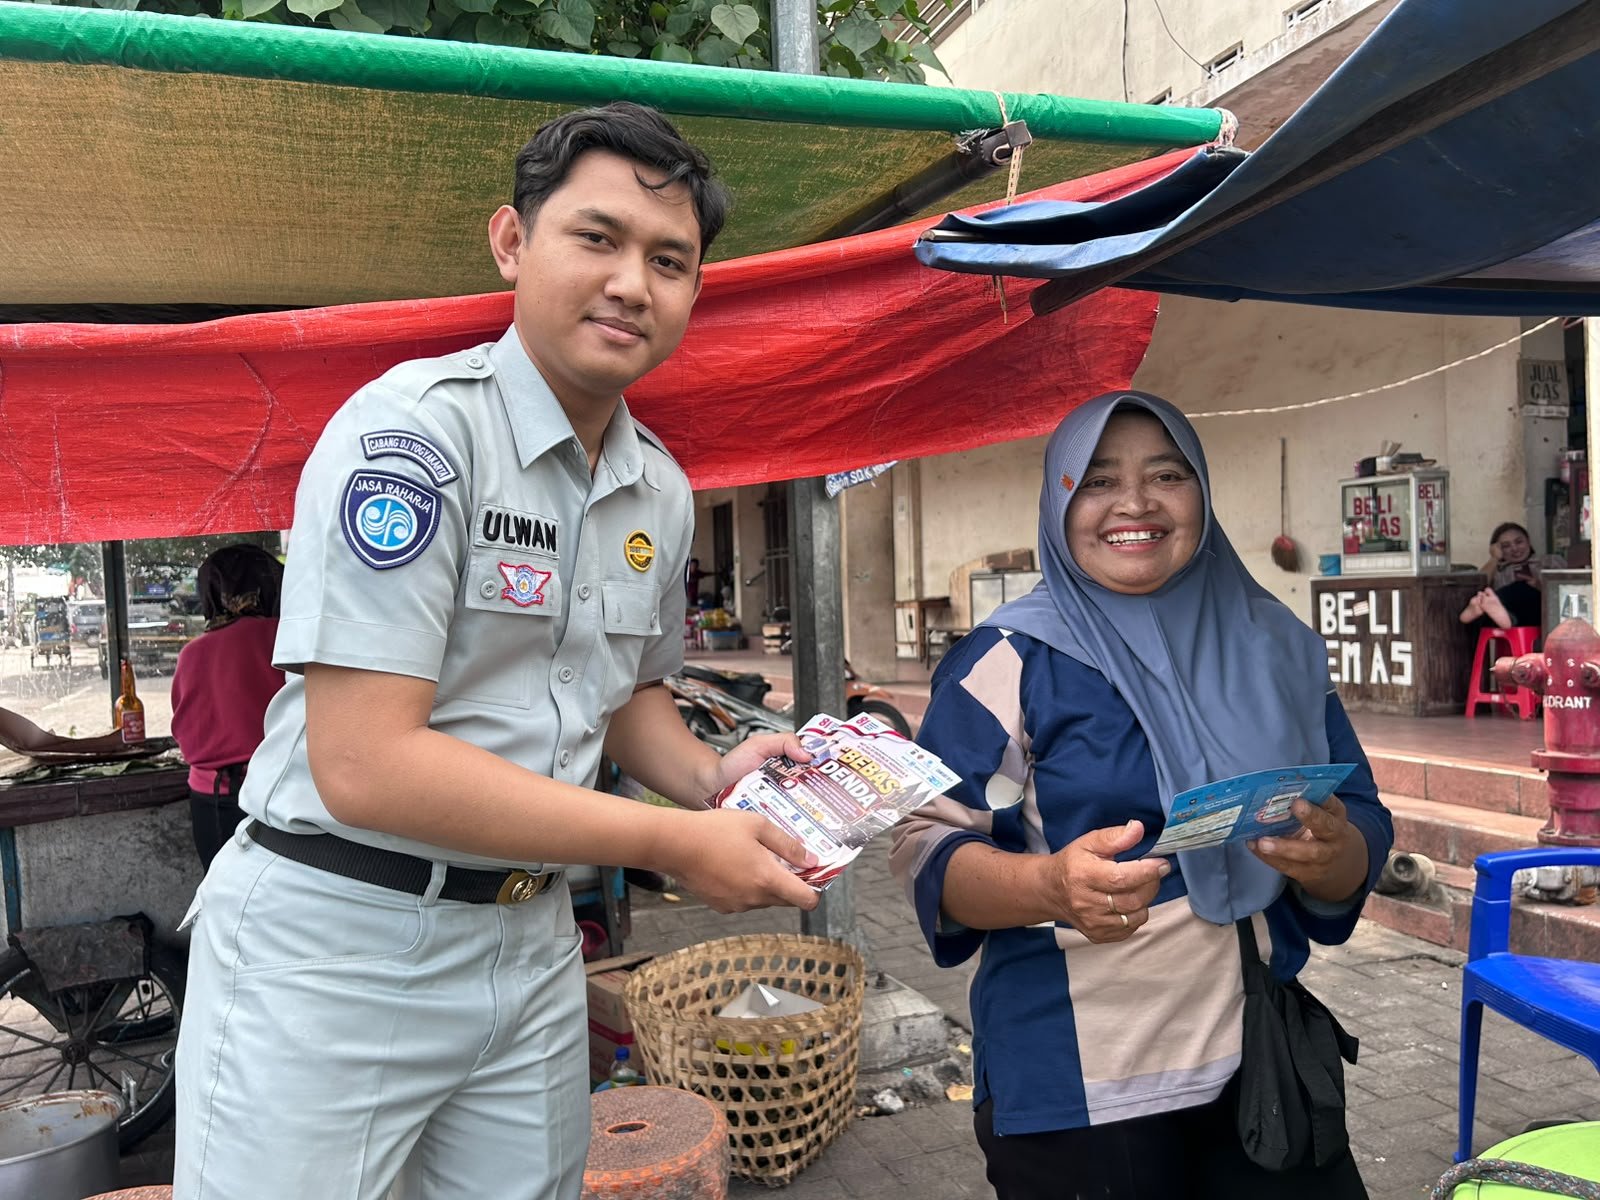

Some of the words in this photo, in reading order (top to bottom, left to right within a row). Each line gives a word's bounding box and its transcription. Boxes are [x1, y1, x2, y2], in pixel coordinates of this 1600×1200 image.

[1530, 364, 1562, 384] JUAL
[369, 437, 399, 451] CABANG
[410, 442, 449, 479] YOGYAKARTA
[355, 480, 383, 493] JASA
[385, 483, 432, 513] RAHARJA
[1353, 494, 1392, 516] BELI
[482, 510, 557, 553] ULWAN
[817, 759, 878, 809] DENDA
